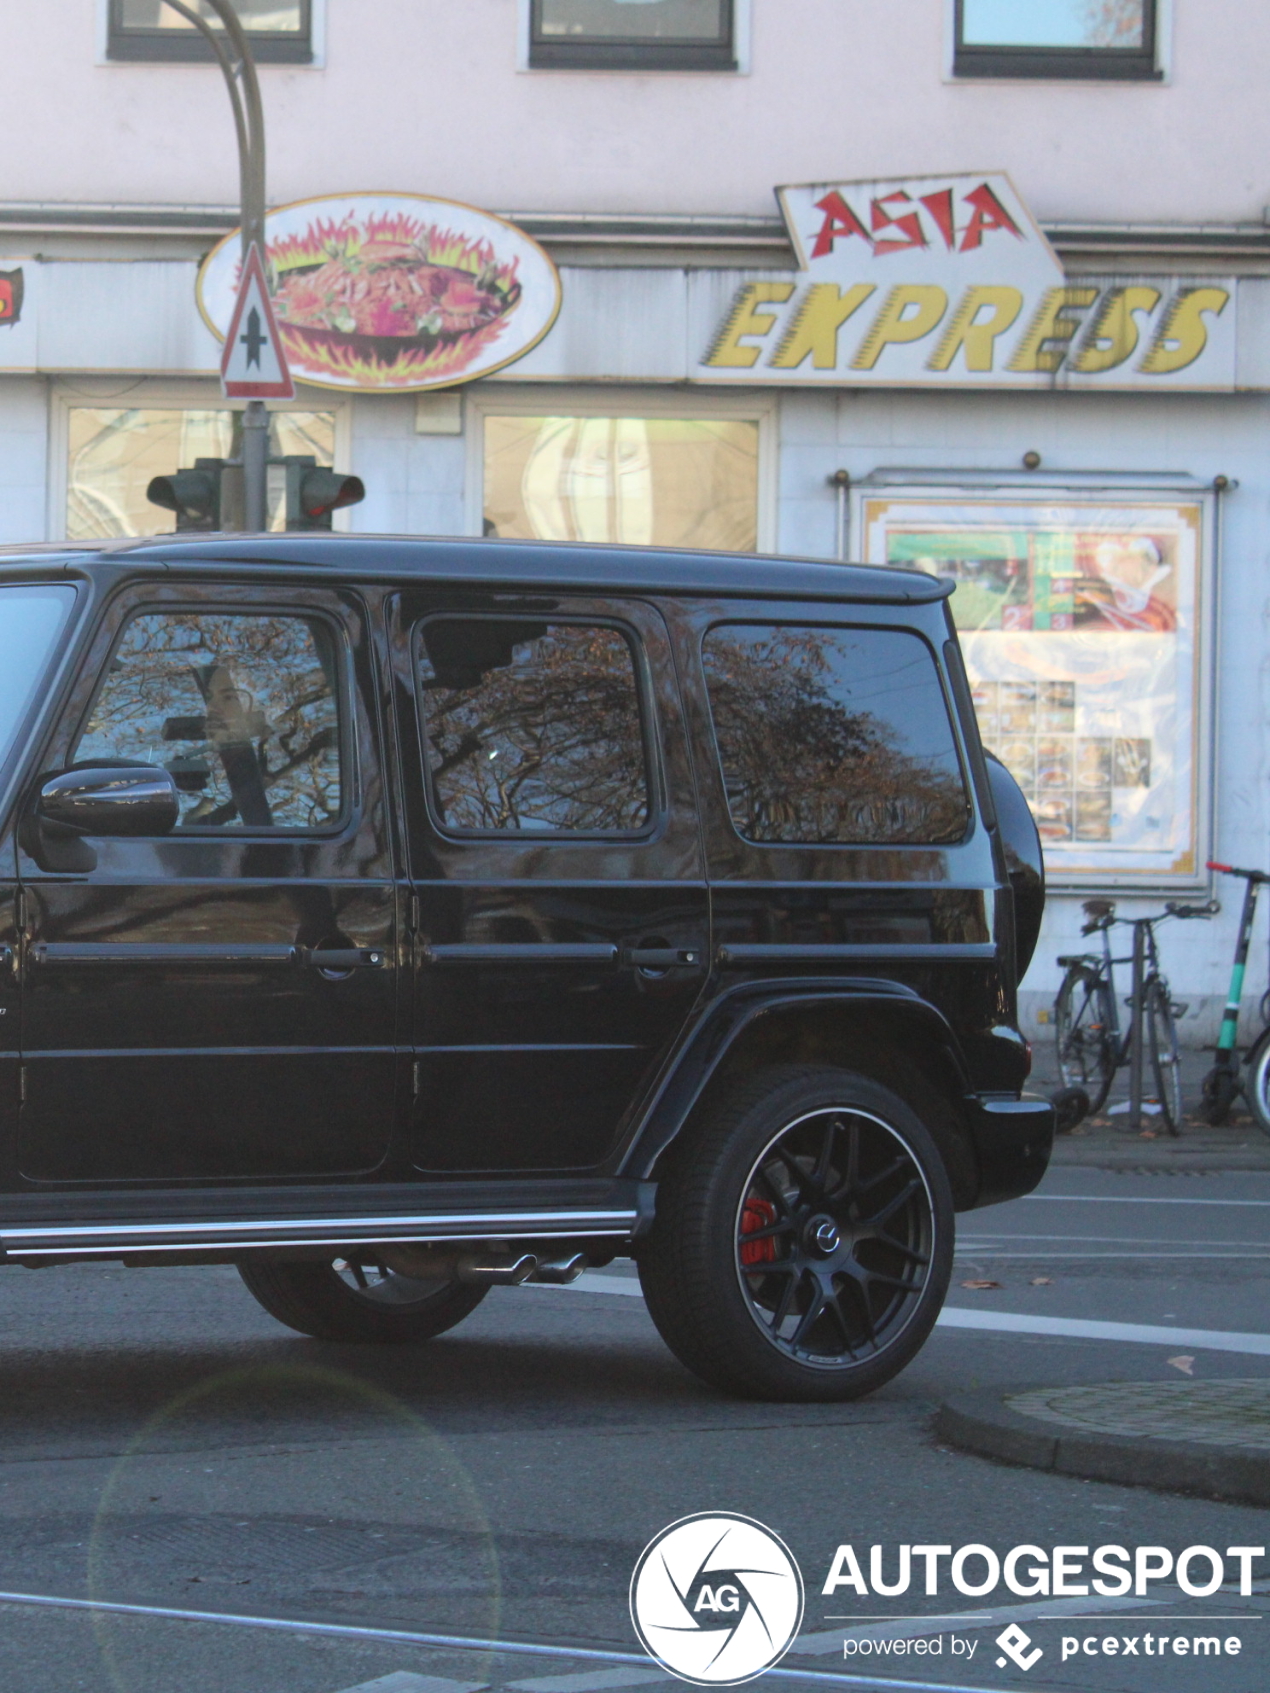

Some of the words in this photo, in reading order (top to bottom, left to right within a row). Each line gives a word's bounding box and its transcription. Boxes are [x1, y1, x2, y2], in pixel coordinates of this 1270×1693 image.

[809, 182, 1027, 259] ASIA
[699, 281, 1230, 375] EXPRESS
[1004, 607, 1021, 630] 2
